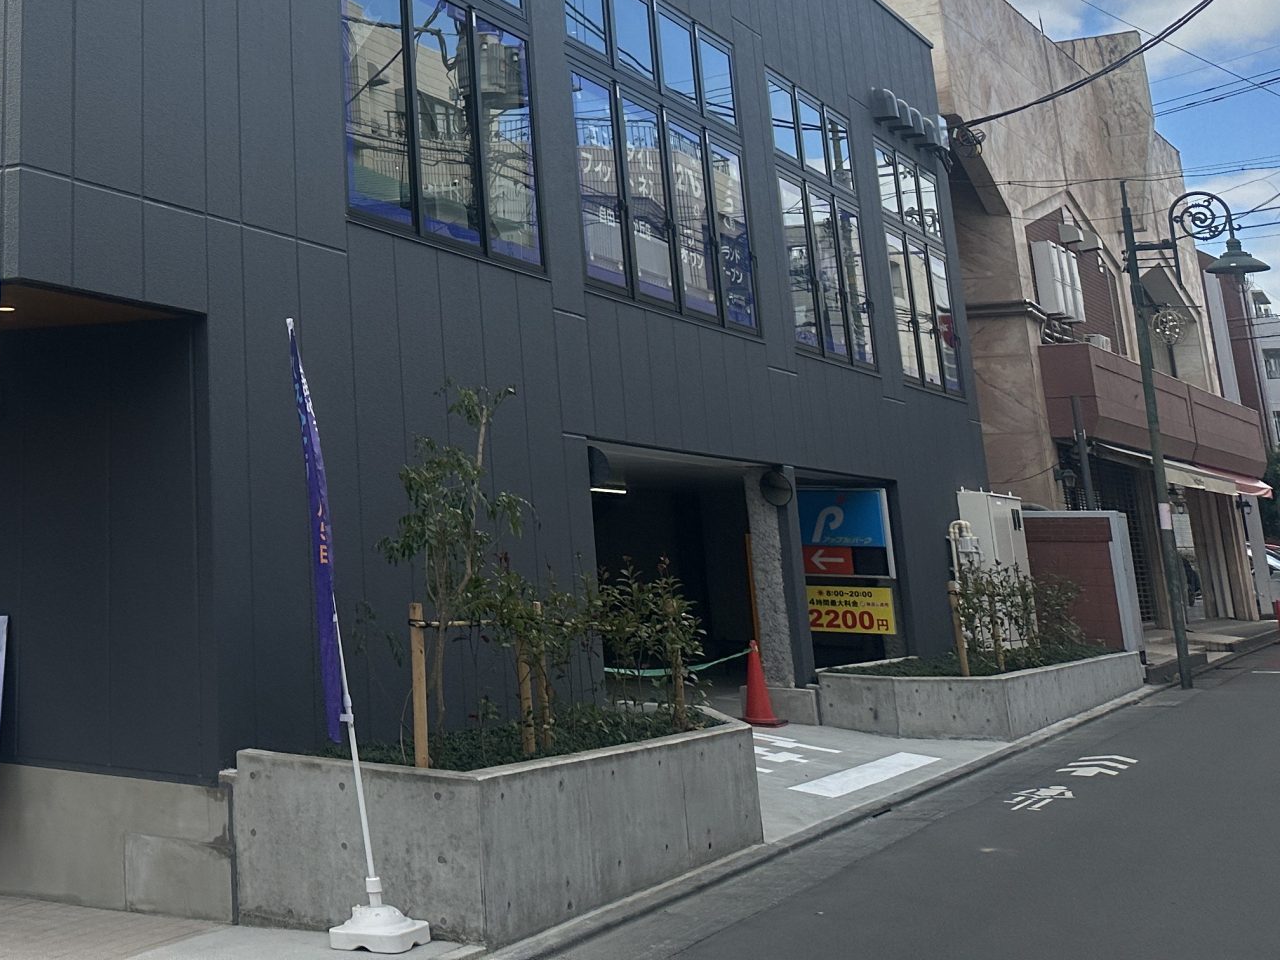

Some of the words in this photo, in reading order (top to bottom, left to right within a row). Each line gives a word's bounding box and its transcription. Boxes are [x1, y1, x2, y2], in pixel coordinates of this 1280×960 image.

[721, 245, 741, 264] ランド
[723, 267, 743, 284] ープン
